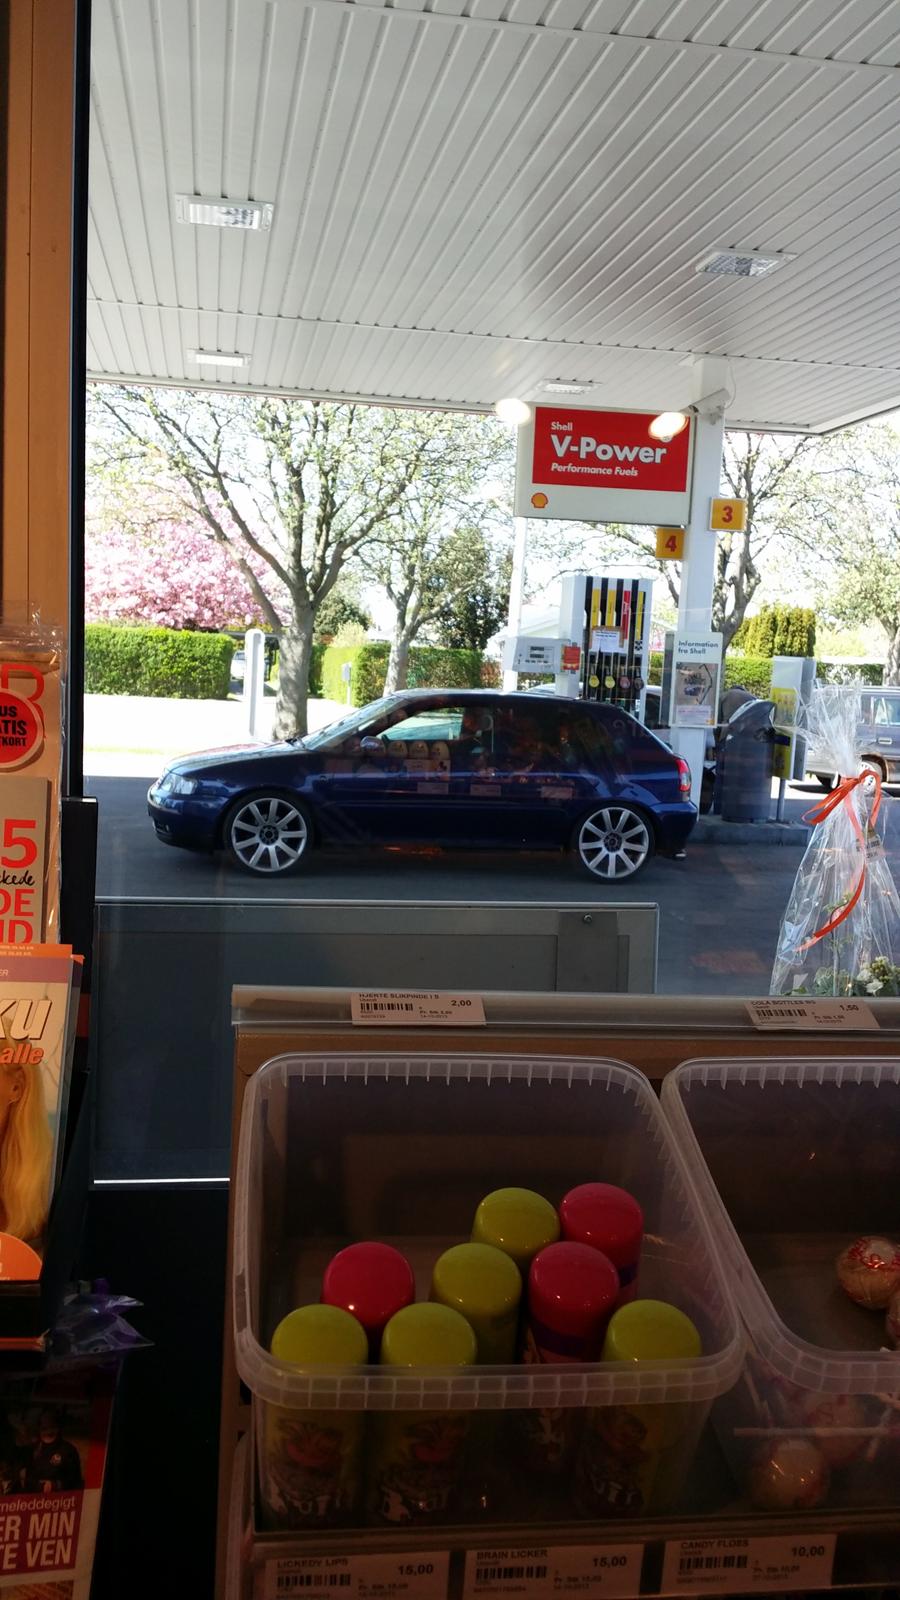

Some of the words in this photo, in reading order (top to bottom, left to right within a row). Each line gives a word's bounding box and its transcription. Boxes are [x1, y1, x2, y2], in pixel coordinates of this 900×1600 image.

[551, 421, 573, 431] Shell
[550, 434, 667, 464] V-Power
[551, 463, 612, 475] Performance
[614, 466, 638, 477] Fuels
[721, 505, 733, 523] 3
[664, 535, 677, 552] 4
[678, 640, 719, 648] Information
[0, 719, 27, 736] TIS
[0, 736, 26, 747] KORT
[0, 870, 35, 886] kede
[450, 999, 472, 1008] 2,00
[840, 1004, 860, 1012] 1,50
[0, 1042, 45, 1065] alle
[0, 1496, 76, 1512] neleddegigt
[28, 1511, 76, 1540] MIN
[681, 1541, 715, 1550] CANDY
[791, 1545, 825, 1559] 10,00
[0, 1543, 19, 1570] E
[26, 1538, 73, 1568] VEN
[476, 1551, 508, 1561] BRAIN
[510, 1549, 548, 1559] LICKER
[277, 1559, 322, 1569] LICKEDY
[325, 1557, 349, 1567] LIPS
[592, 1556, 628, 1568] 15,00
[397, 1563, 435, 1577] 15,00
